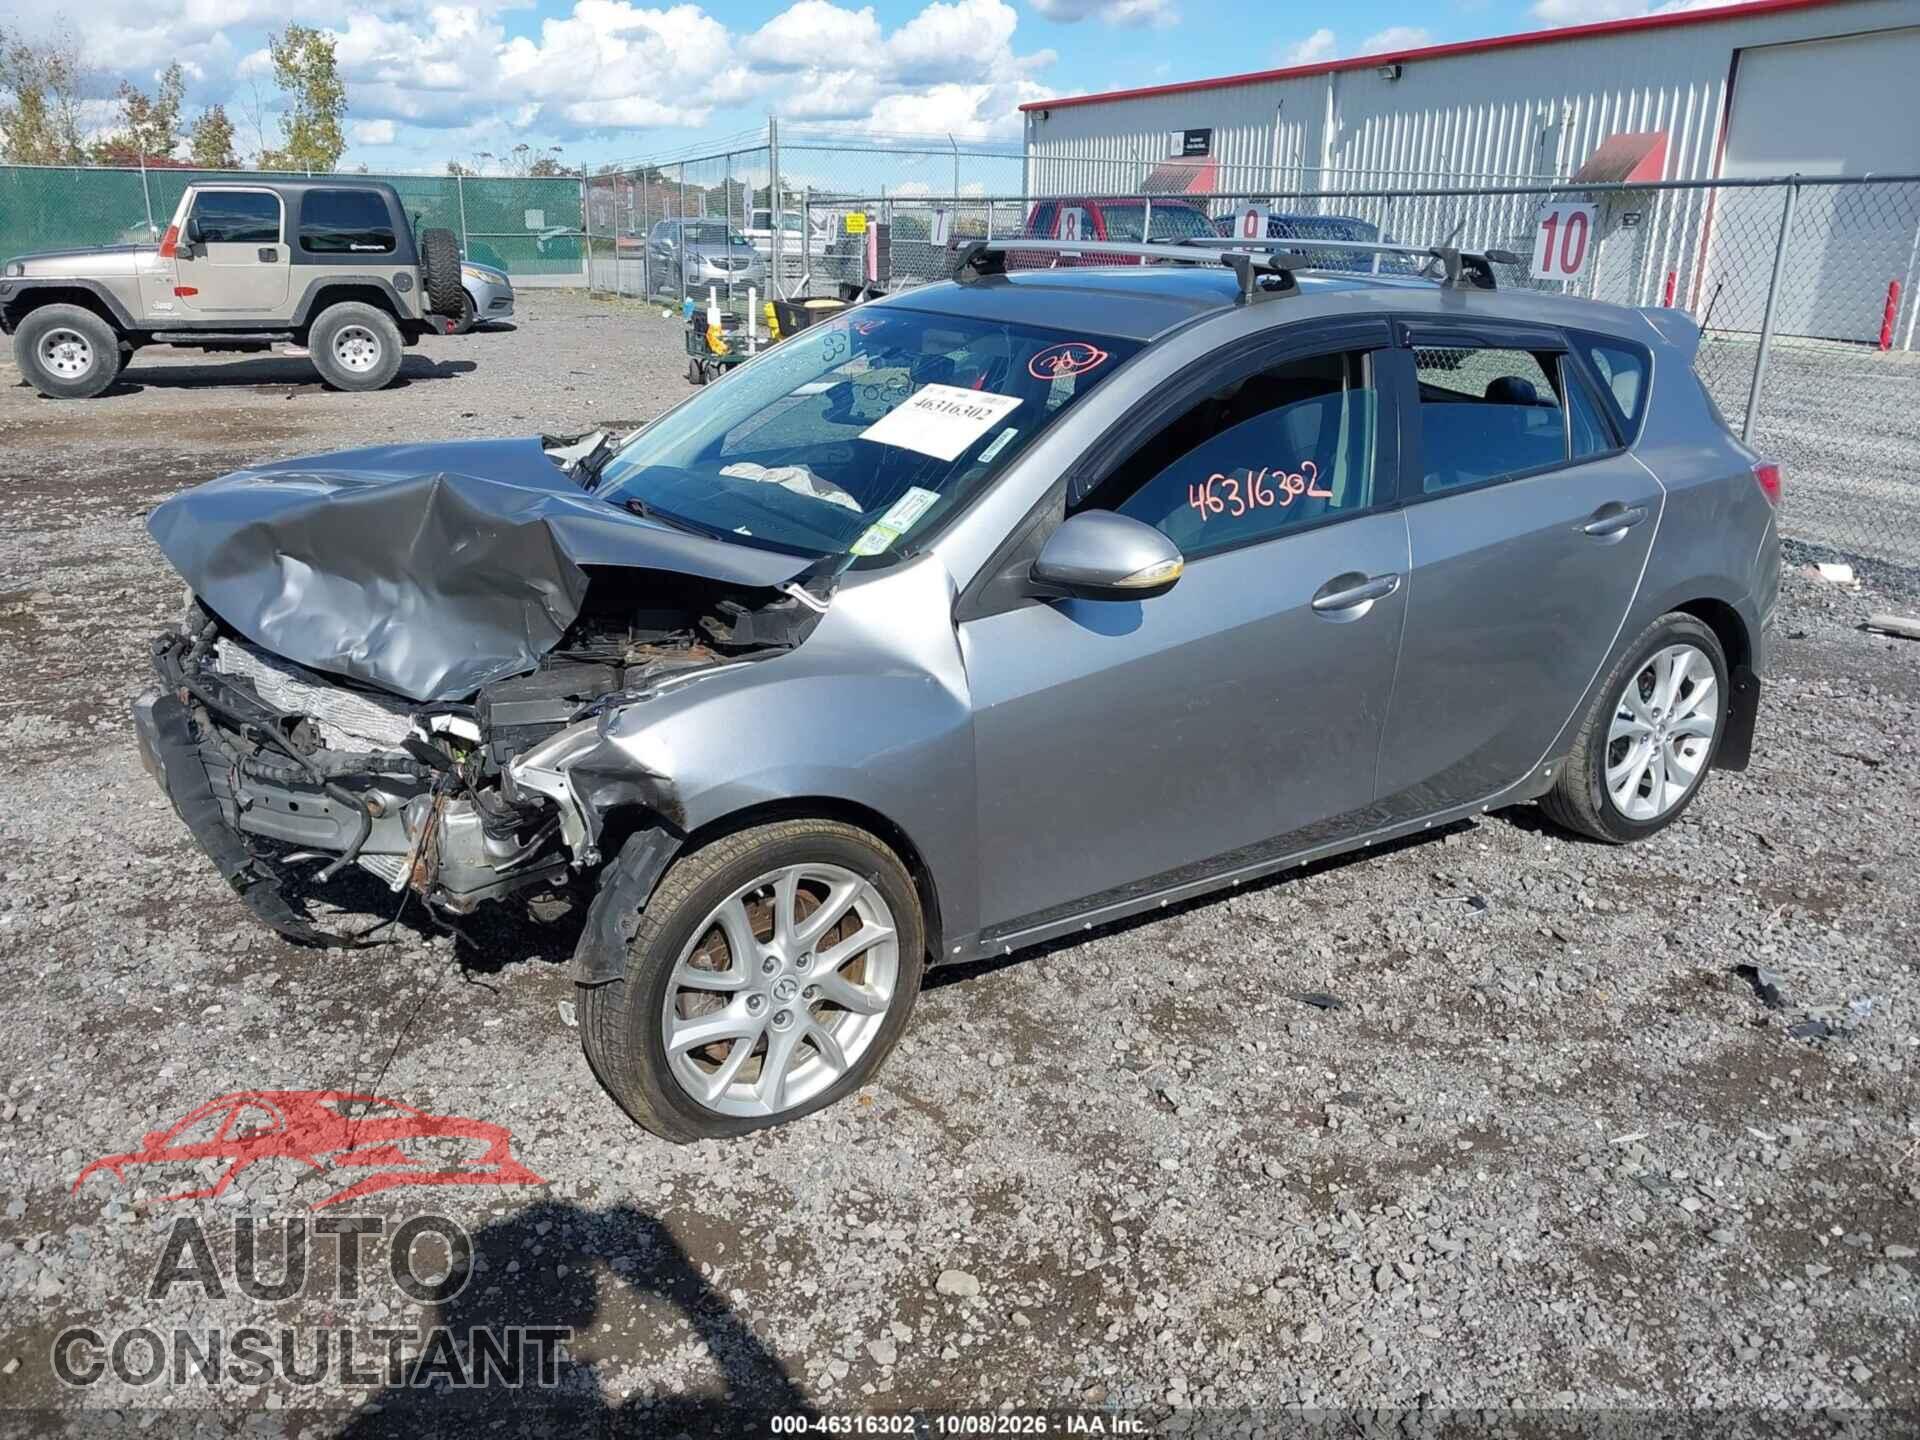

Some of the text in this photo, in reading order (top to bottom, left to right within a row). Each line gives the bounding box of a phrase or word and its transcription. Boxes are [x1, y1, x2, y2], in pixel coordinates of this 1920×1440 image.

[936, 209, 944, 241] 7
[1541, 210, 1588, 275] 10
[914, 398, 992, 421] 46316302
[1189, 460, 1333, 522] 46316302
